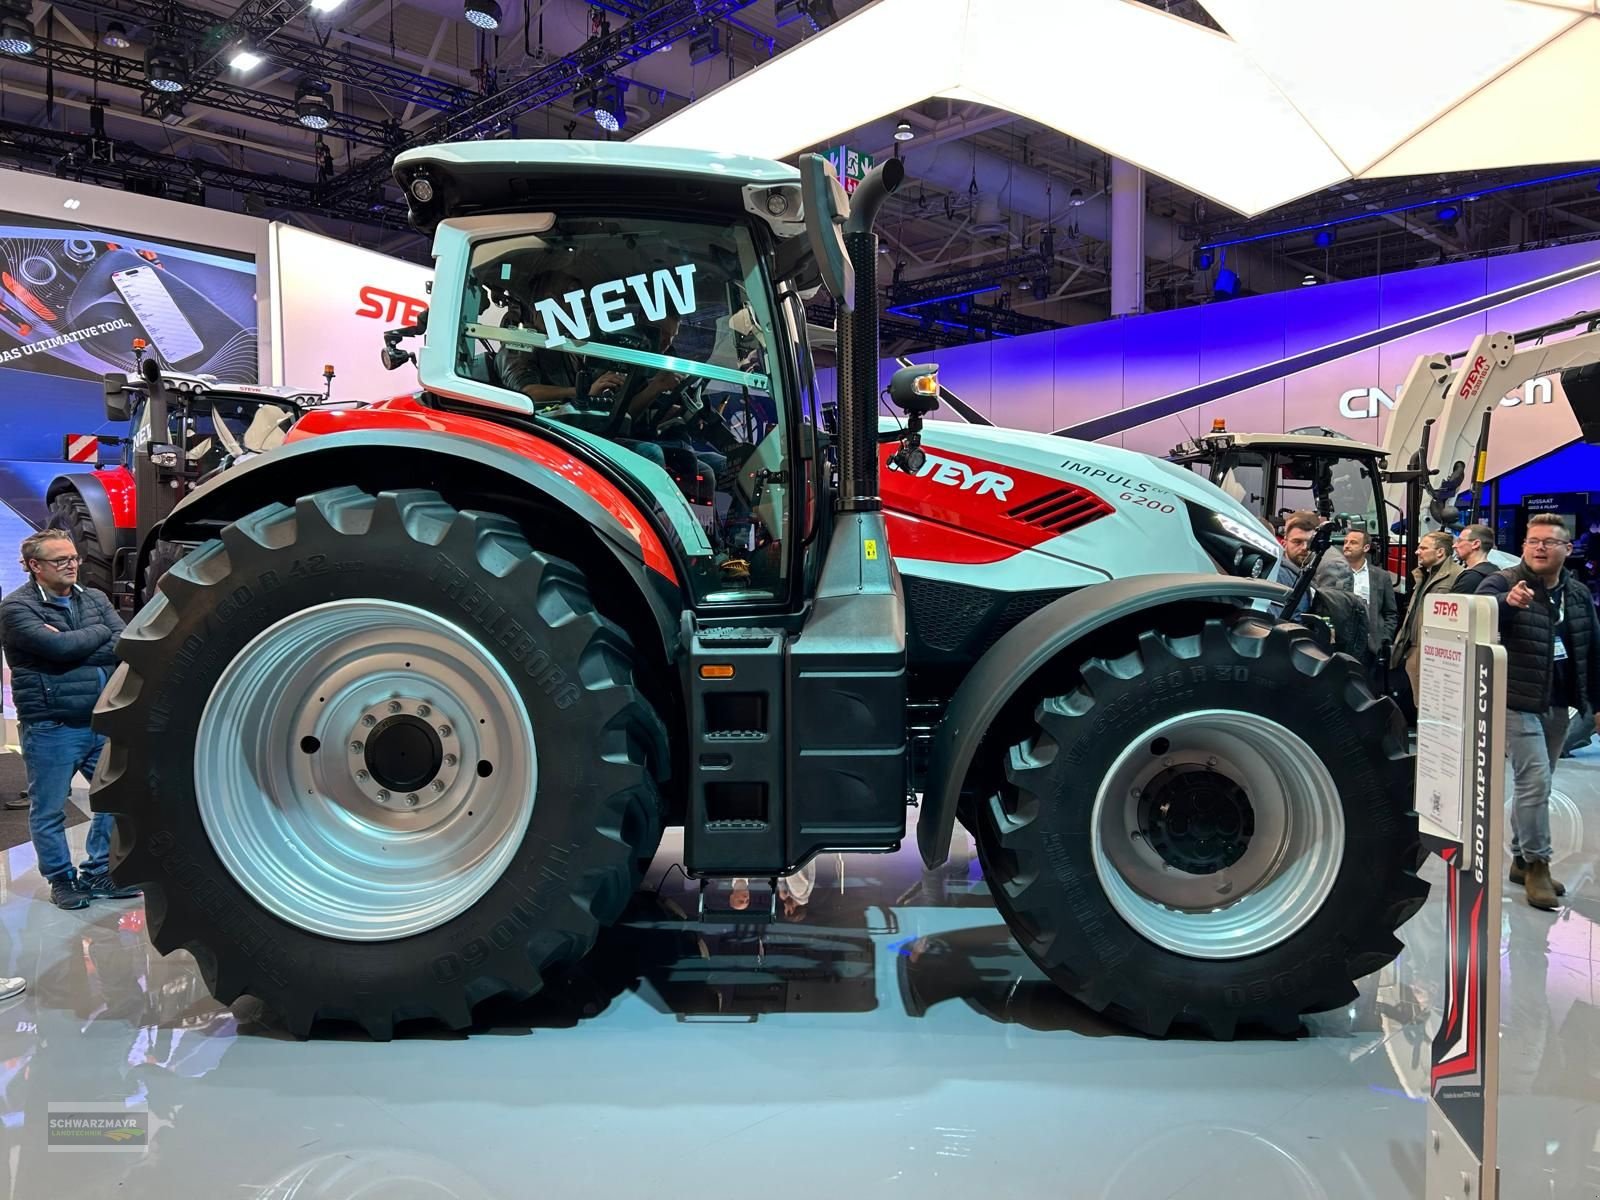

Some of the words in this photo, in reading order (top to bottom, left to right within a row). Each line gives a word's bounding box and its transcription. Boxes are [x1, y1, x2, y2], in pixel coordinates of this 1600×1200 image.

[355, 286, 429, 326] STE
[534, 263, 696, 349] NEW
[21, 327, 98, 355] ULTIMATIVE
[97, 318, 132, 334] TOOL,
[1460, 355, 1487, 400] STEYR
[1339, 384, 1404, 419] CN
[886, 453, 1014, 502] TEYR
[1060, 460, 1152, 494] IMPULS
[1119, 491, 1175, 514] 6200
[428, 551, 582, 711] TRELLEBORG
[1433, 601, 1459, 617] STEYR
[1478, 664, 1488, 713] CVT
[1476, 719, 1487, 819] IMPULS
[1475, 826, 1485, 884] 6200
